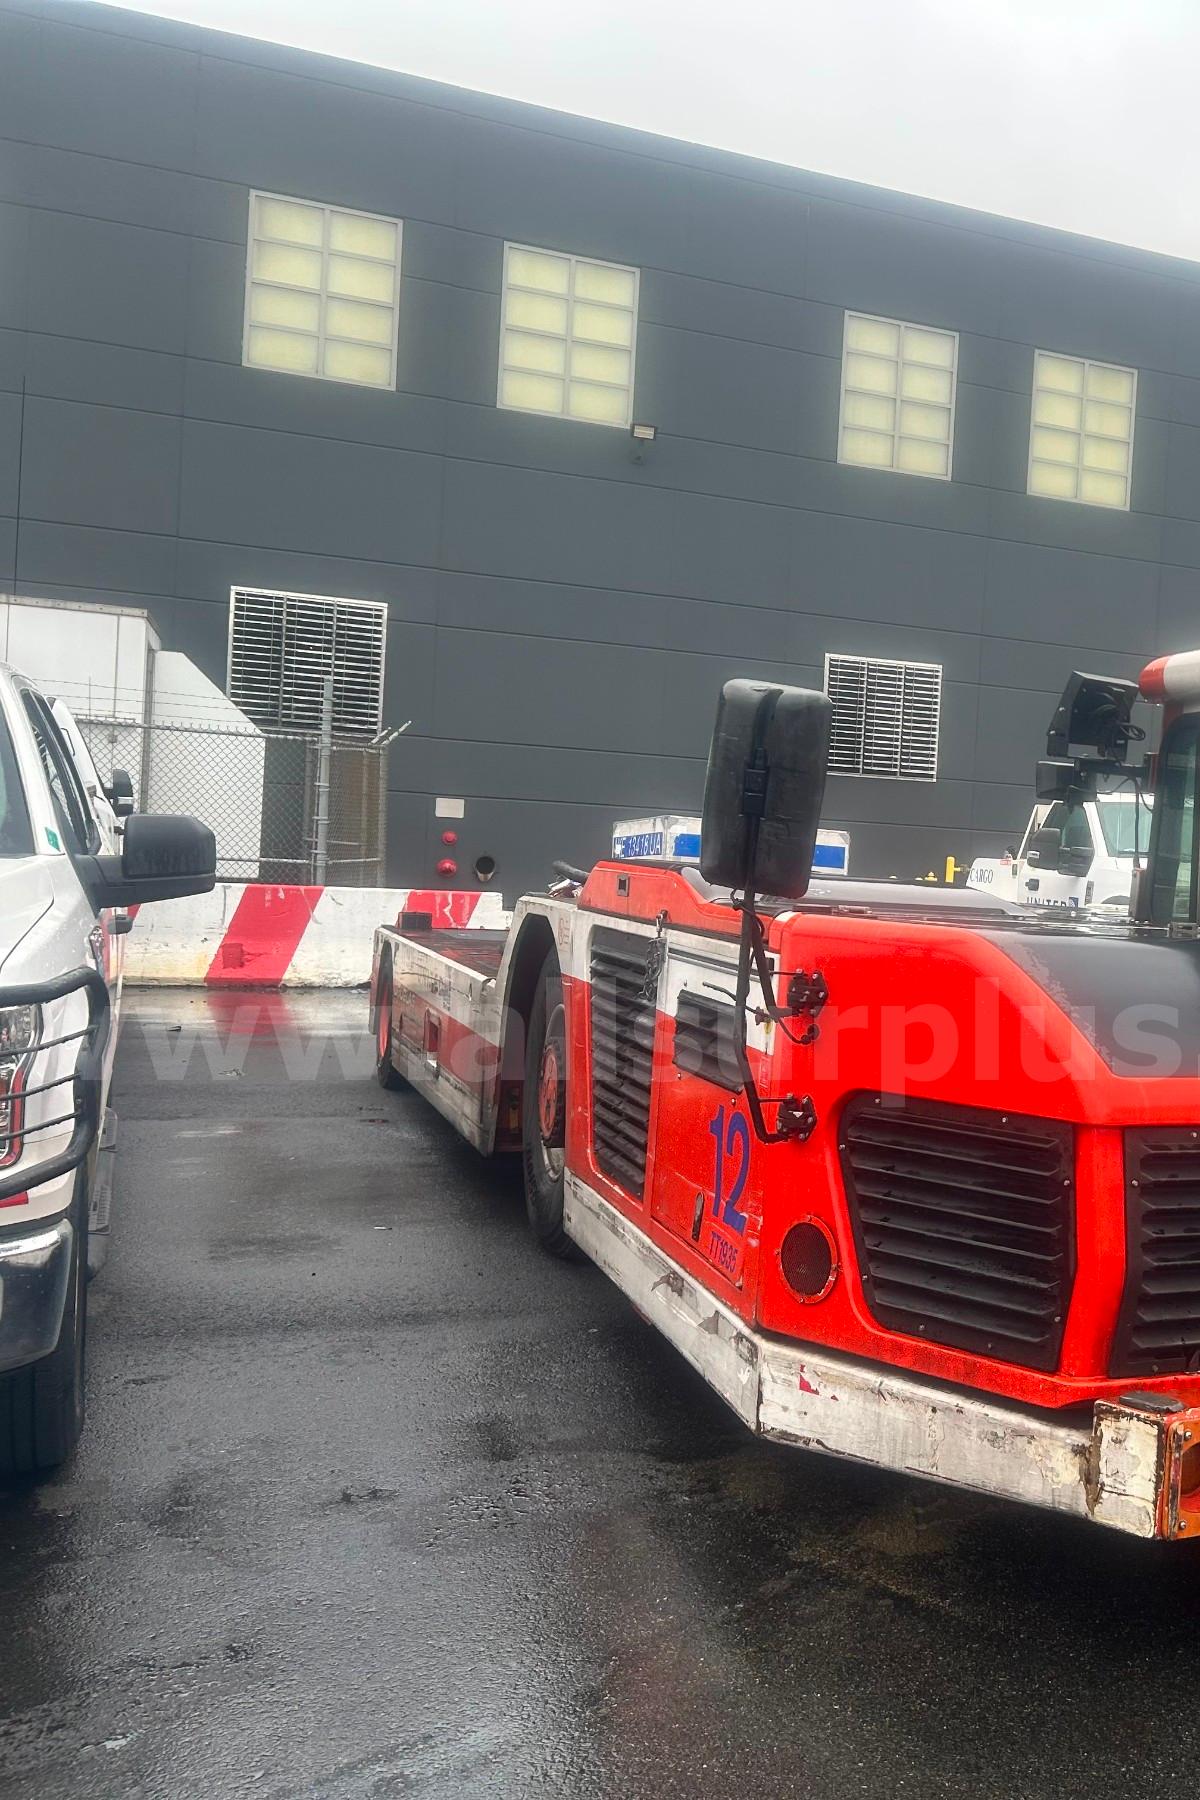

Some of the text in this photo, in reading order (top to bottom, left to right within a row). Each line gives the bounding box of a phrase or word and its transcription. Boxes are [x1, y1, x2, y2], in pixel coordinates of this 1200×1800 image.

[969, 867, 994, 884] CARGO
[709, 1104, 750, 1236] 12
[710, 1230, 739, 1273] TT1935
